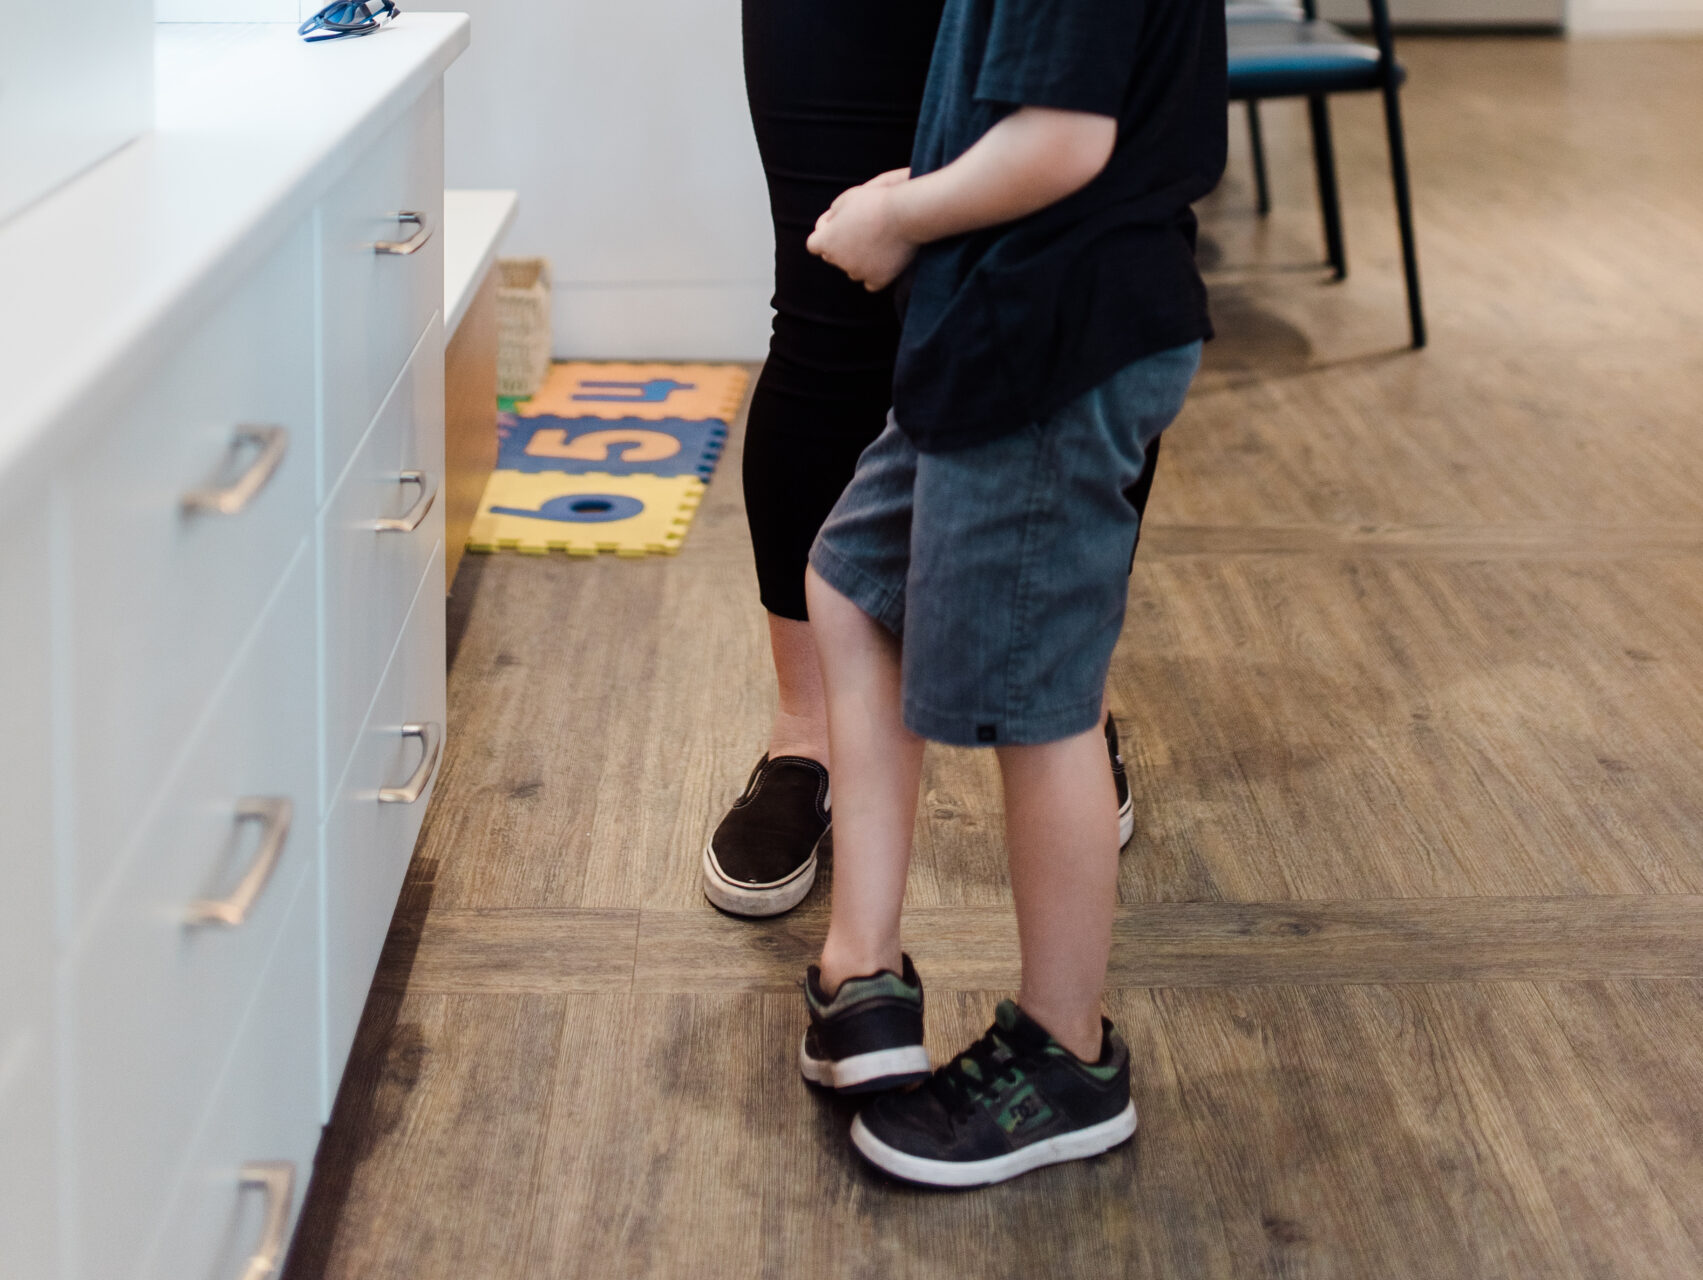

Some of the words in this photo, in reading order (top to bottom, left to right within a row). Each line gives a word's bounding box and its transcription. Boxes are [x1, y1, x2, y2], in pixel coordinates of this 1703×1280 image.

[571, 379, 697, 402] 4
[524, 429, 682, 462] 5
[488, 494, 645, 523] 6
